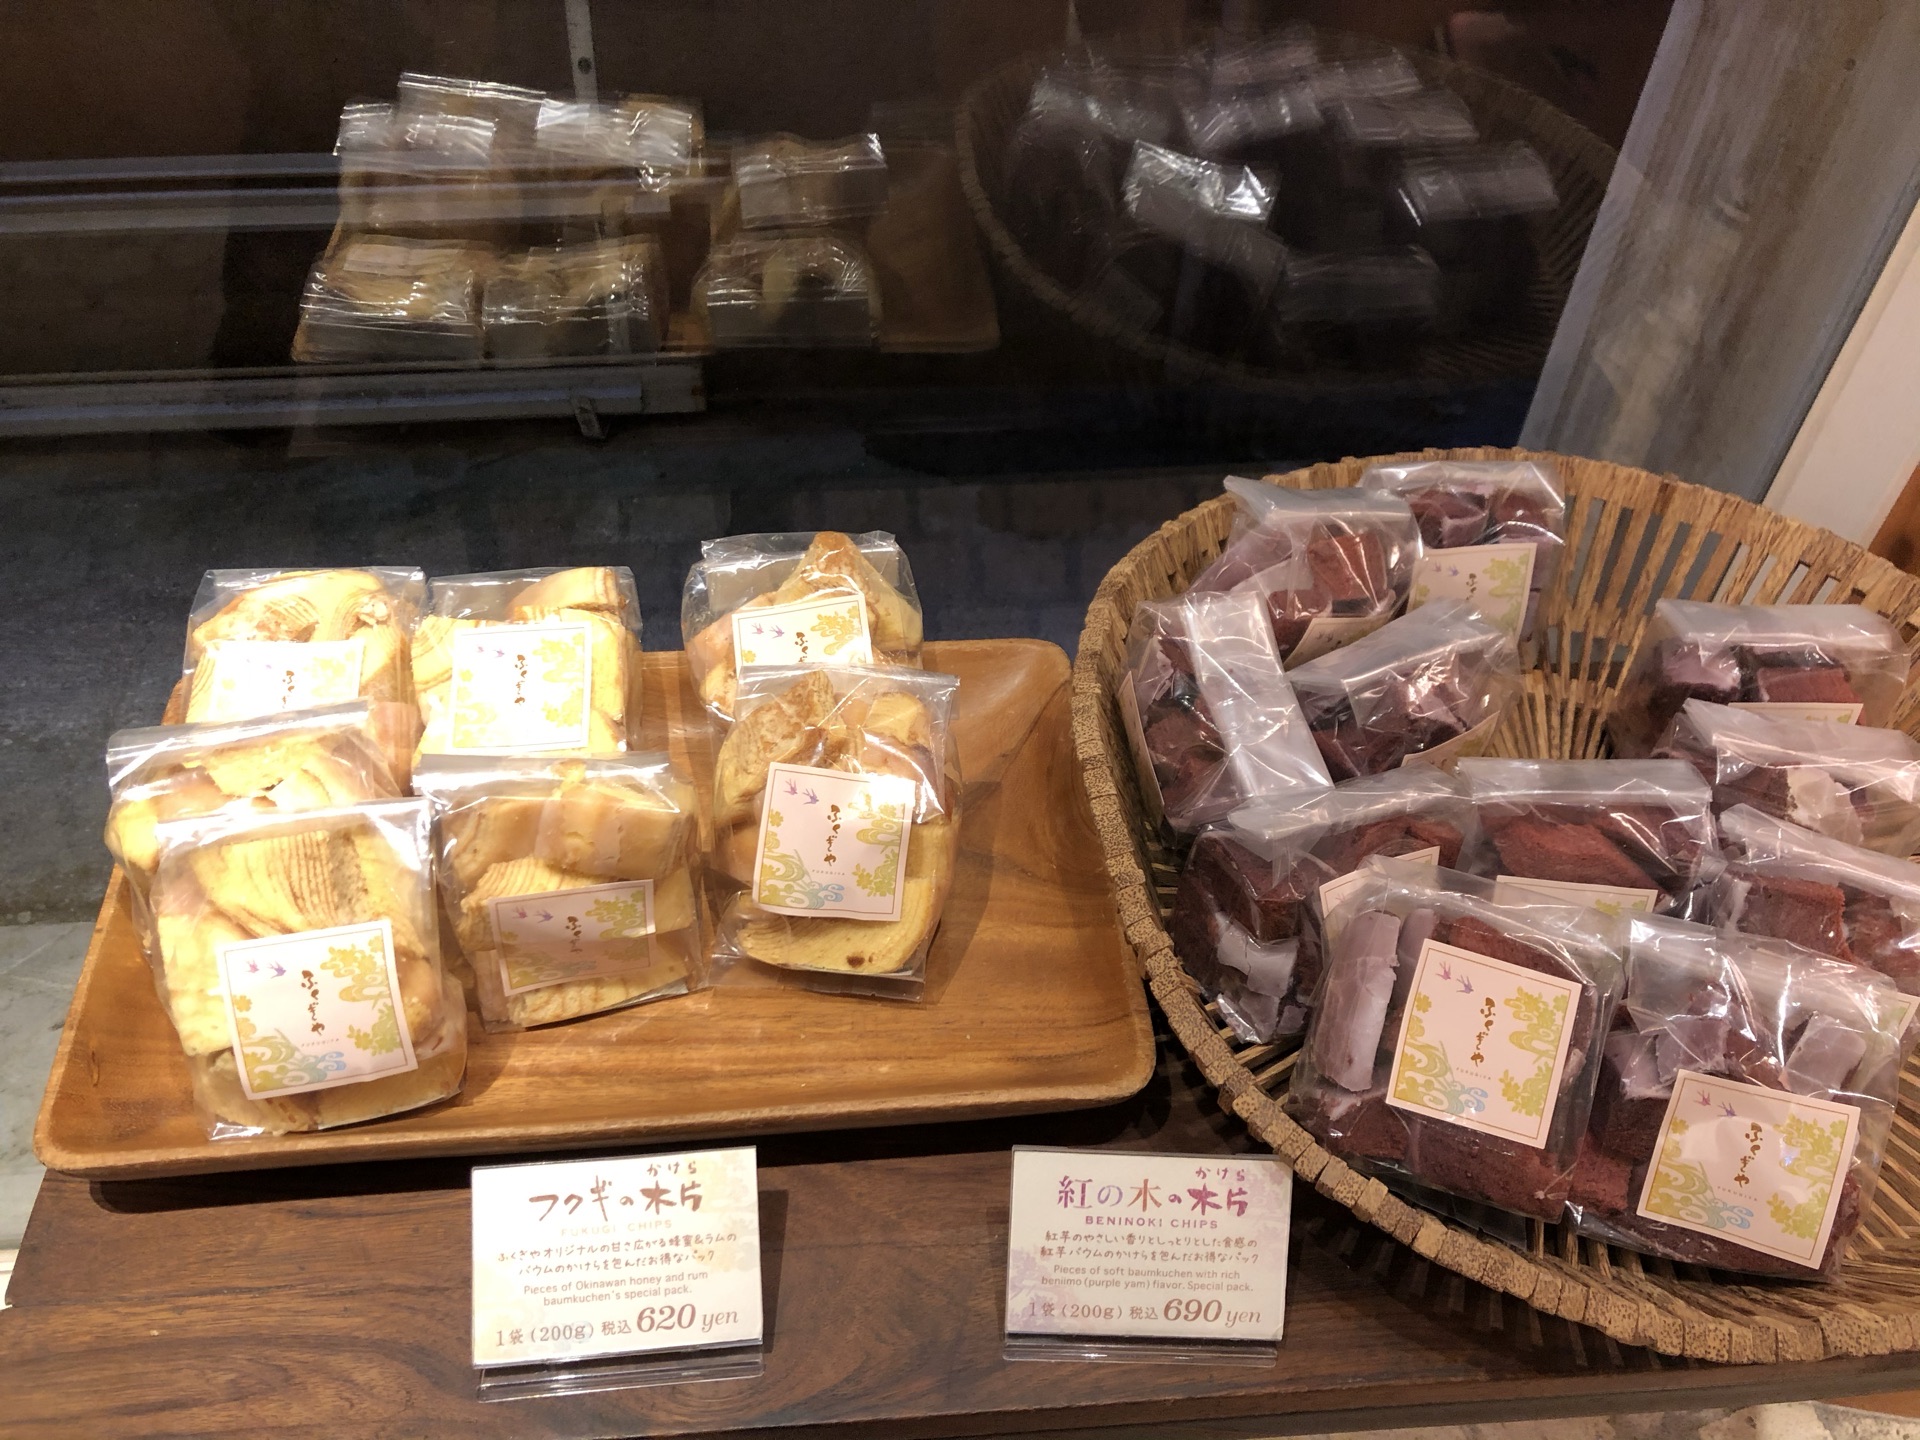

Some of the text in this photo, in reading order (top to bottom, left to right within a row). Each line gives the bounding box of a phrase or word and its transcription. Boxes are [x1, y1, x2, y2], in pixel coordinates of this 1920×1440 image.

[824, 804, 841, 866] ふくぎや
[301, 970, 325, 1036] ふくぎや
[1470, 997, 1496, 1067] ふくぎや
[1734, 1122, 1763, 1188] ふくぎや
[647, 1161, 698, 1178] かけら
[1195, 1166, 1246, 1182] かけら
[529, 1174, 703, 1222] フクギの木片
[1057, 1175, 1249, 1217] 紅の木の木片
[561, 1219, 673, 1237] FUKUGI CHIPS
[1085, 1215, 1219, 1229] BENINOKI CHIPS
[524, 1271, 708, 1295] Pieces of Okinawan honey and rum
[1041, 1276, 1082, 1286] beniimo
[1084, 1277, 1121, 1288] (purple
[1124, 1279, 1151, 1290] yam)
[1187, 1280, 1224, 1292] Special
[1226, 1282, 1254, 1292] pack.
[1053, 1264, 1241, 1279] Pieces of soft baumkuchen with rich
[624, 1287, 661, 1299] special
[664, 1284, 693, 1297] pack.
[601, 1320, 632, 1337] 税込
[636, 1303, 697, 1333] 620
[701, 1311, 739, 1333] yen
[1129, 1305, 1159, 1321] 税込
[1163, 1298, 1222, 1324] 690
[1225, 1309, 1262, 1328] yen
